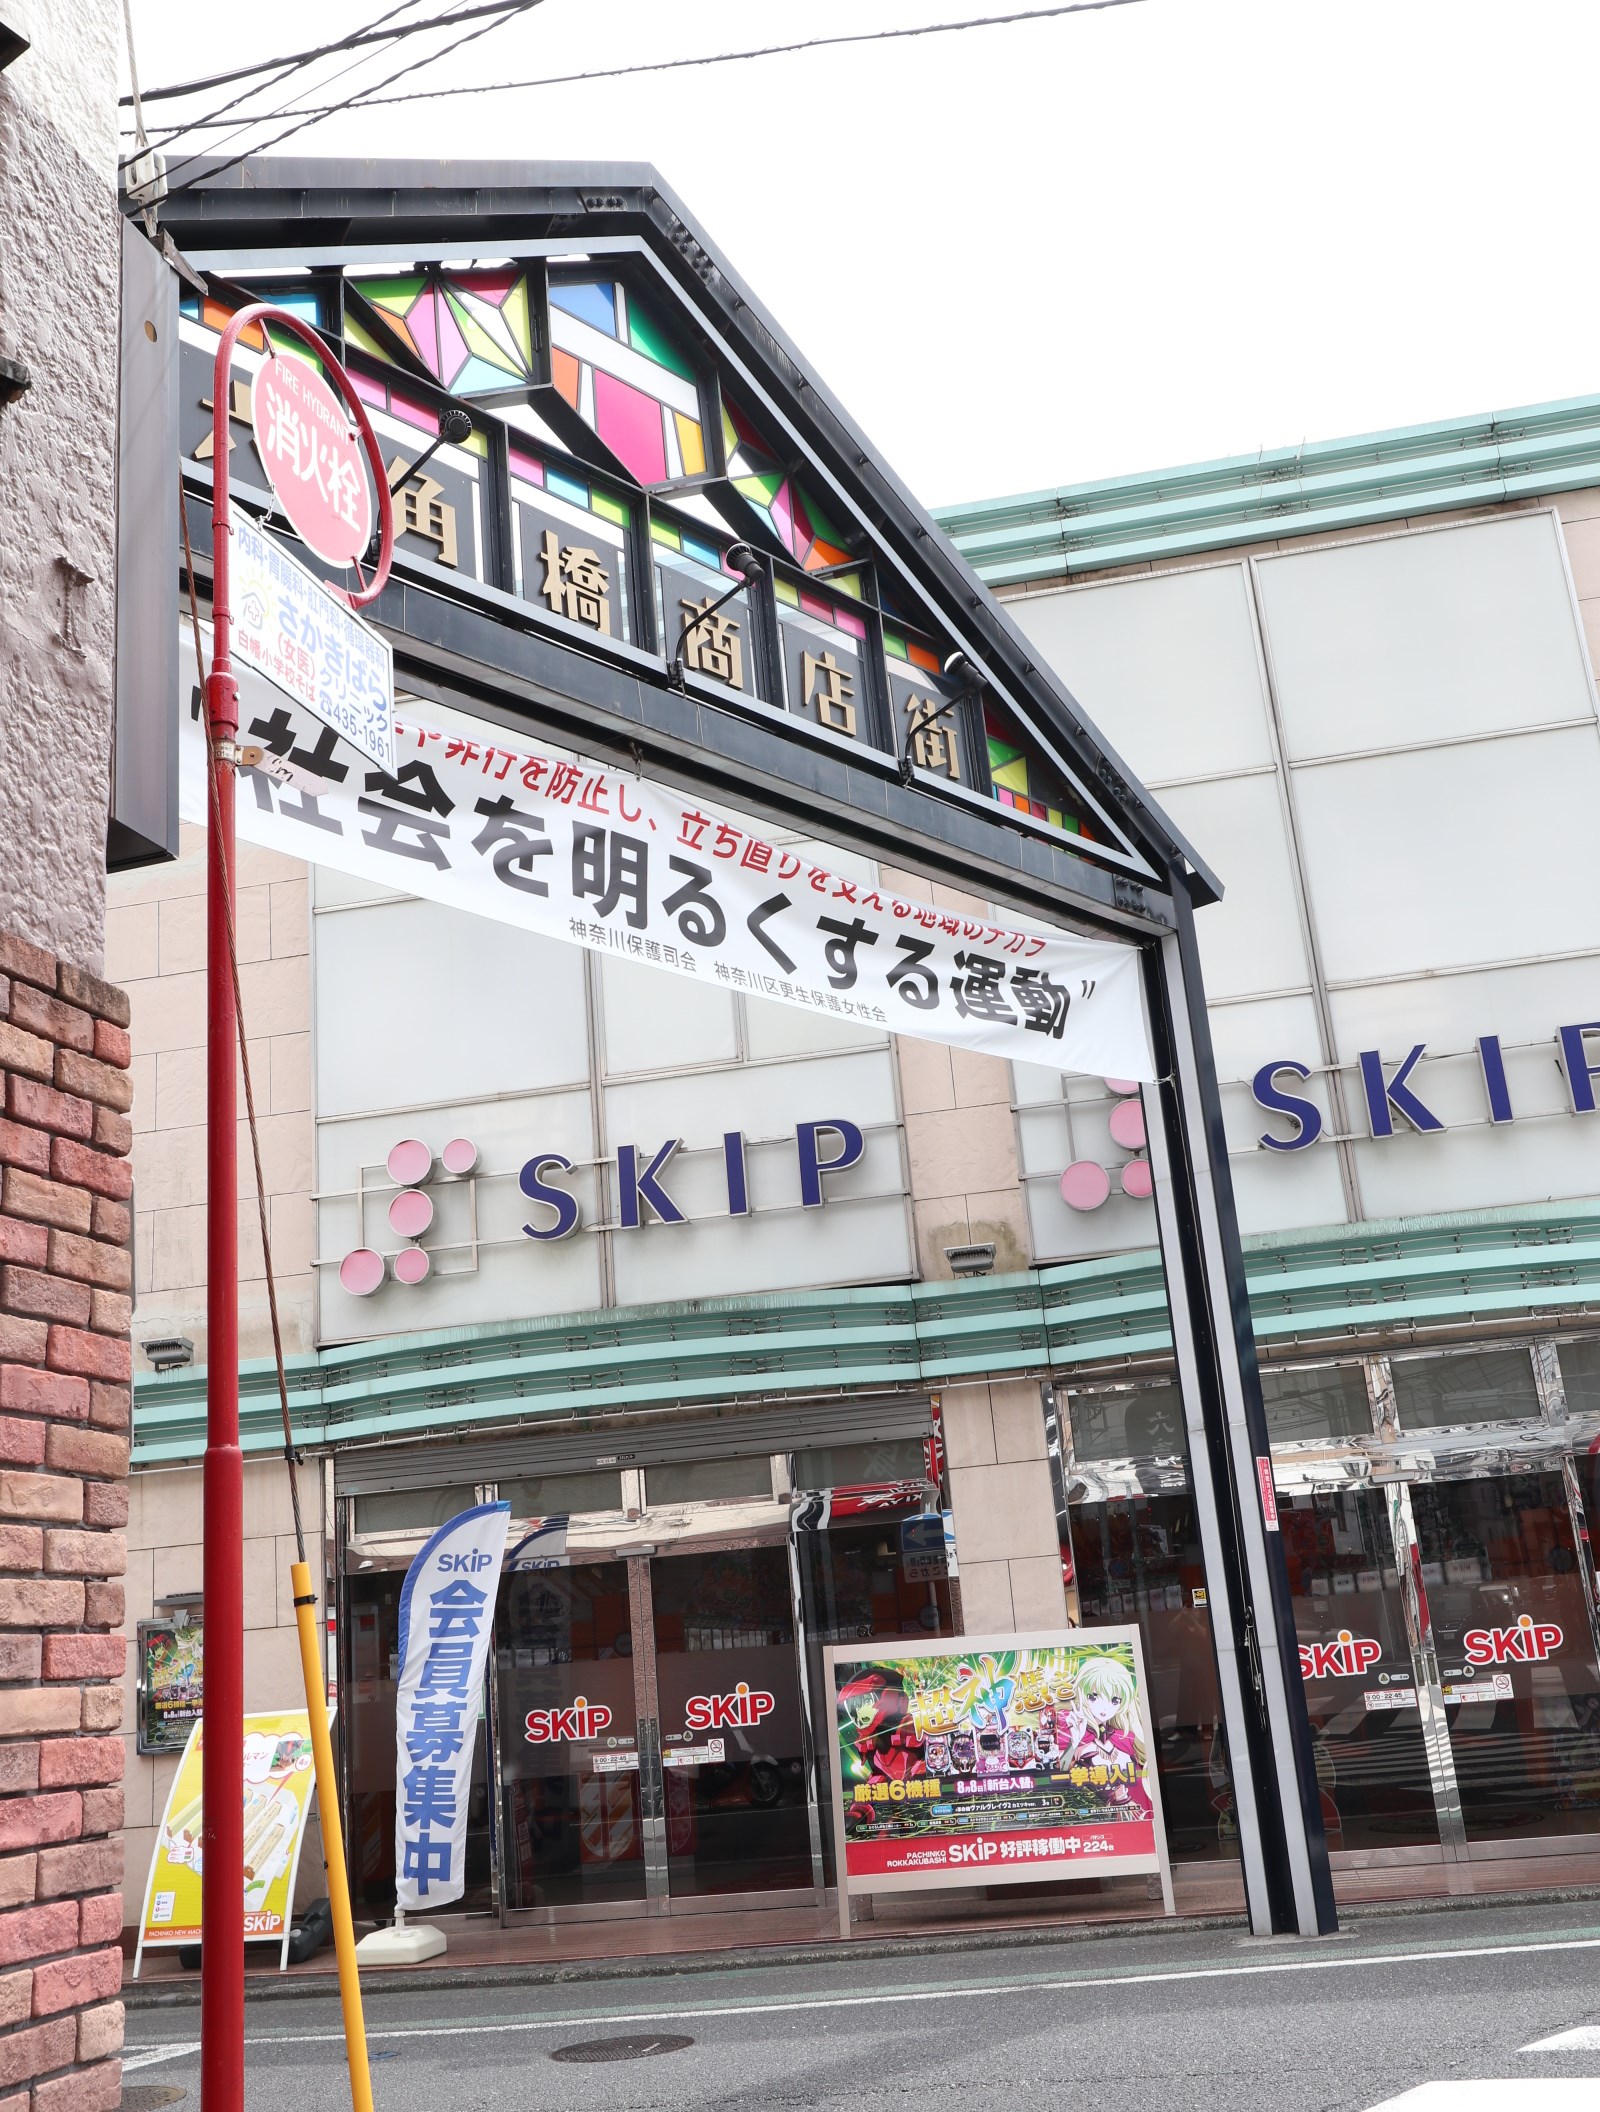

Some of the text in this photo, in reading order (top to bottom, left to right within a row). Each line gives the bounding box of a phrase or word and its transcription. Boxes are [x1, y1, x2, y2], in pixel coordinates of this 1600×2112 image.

[275, 359, 351, 445] FIRE HYDRANT
[266, 383, 362, 533] 消火栓
[238, 629, 316, 702] 白幡小学校そば
[278, 594, 388, 712] さかきばら
[320, 668, 388, 732] クリニック
[568, 916, 888, 1023] 神奈川保護司会 神奈川区更生保護女性会
[1250, 1021, 1600, 1153] SKIP
[518, 1118, 866, 1241] SKIP
[402, 1579, 489, 1896] 会員募集中
[1051, 1762, 1137, 1787] 一挙導入!
[854, 1779, 941, 1802] 厳選6機種
[886, 1857, 946, 1867] ROKKAKUBASHI
[906, 1850, 946, 1859] PACHINKO
[1000, 1836, 1081, 1859] 好評稼働中
